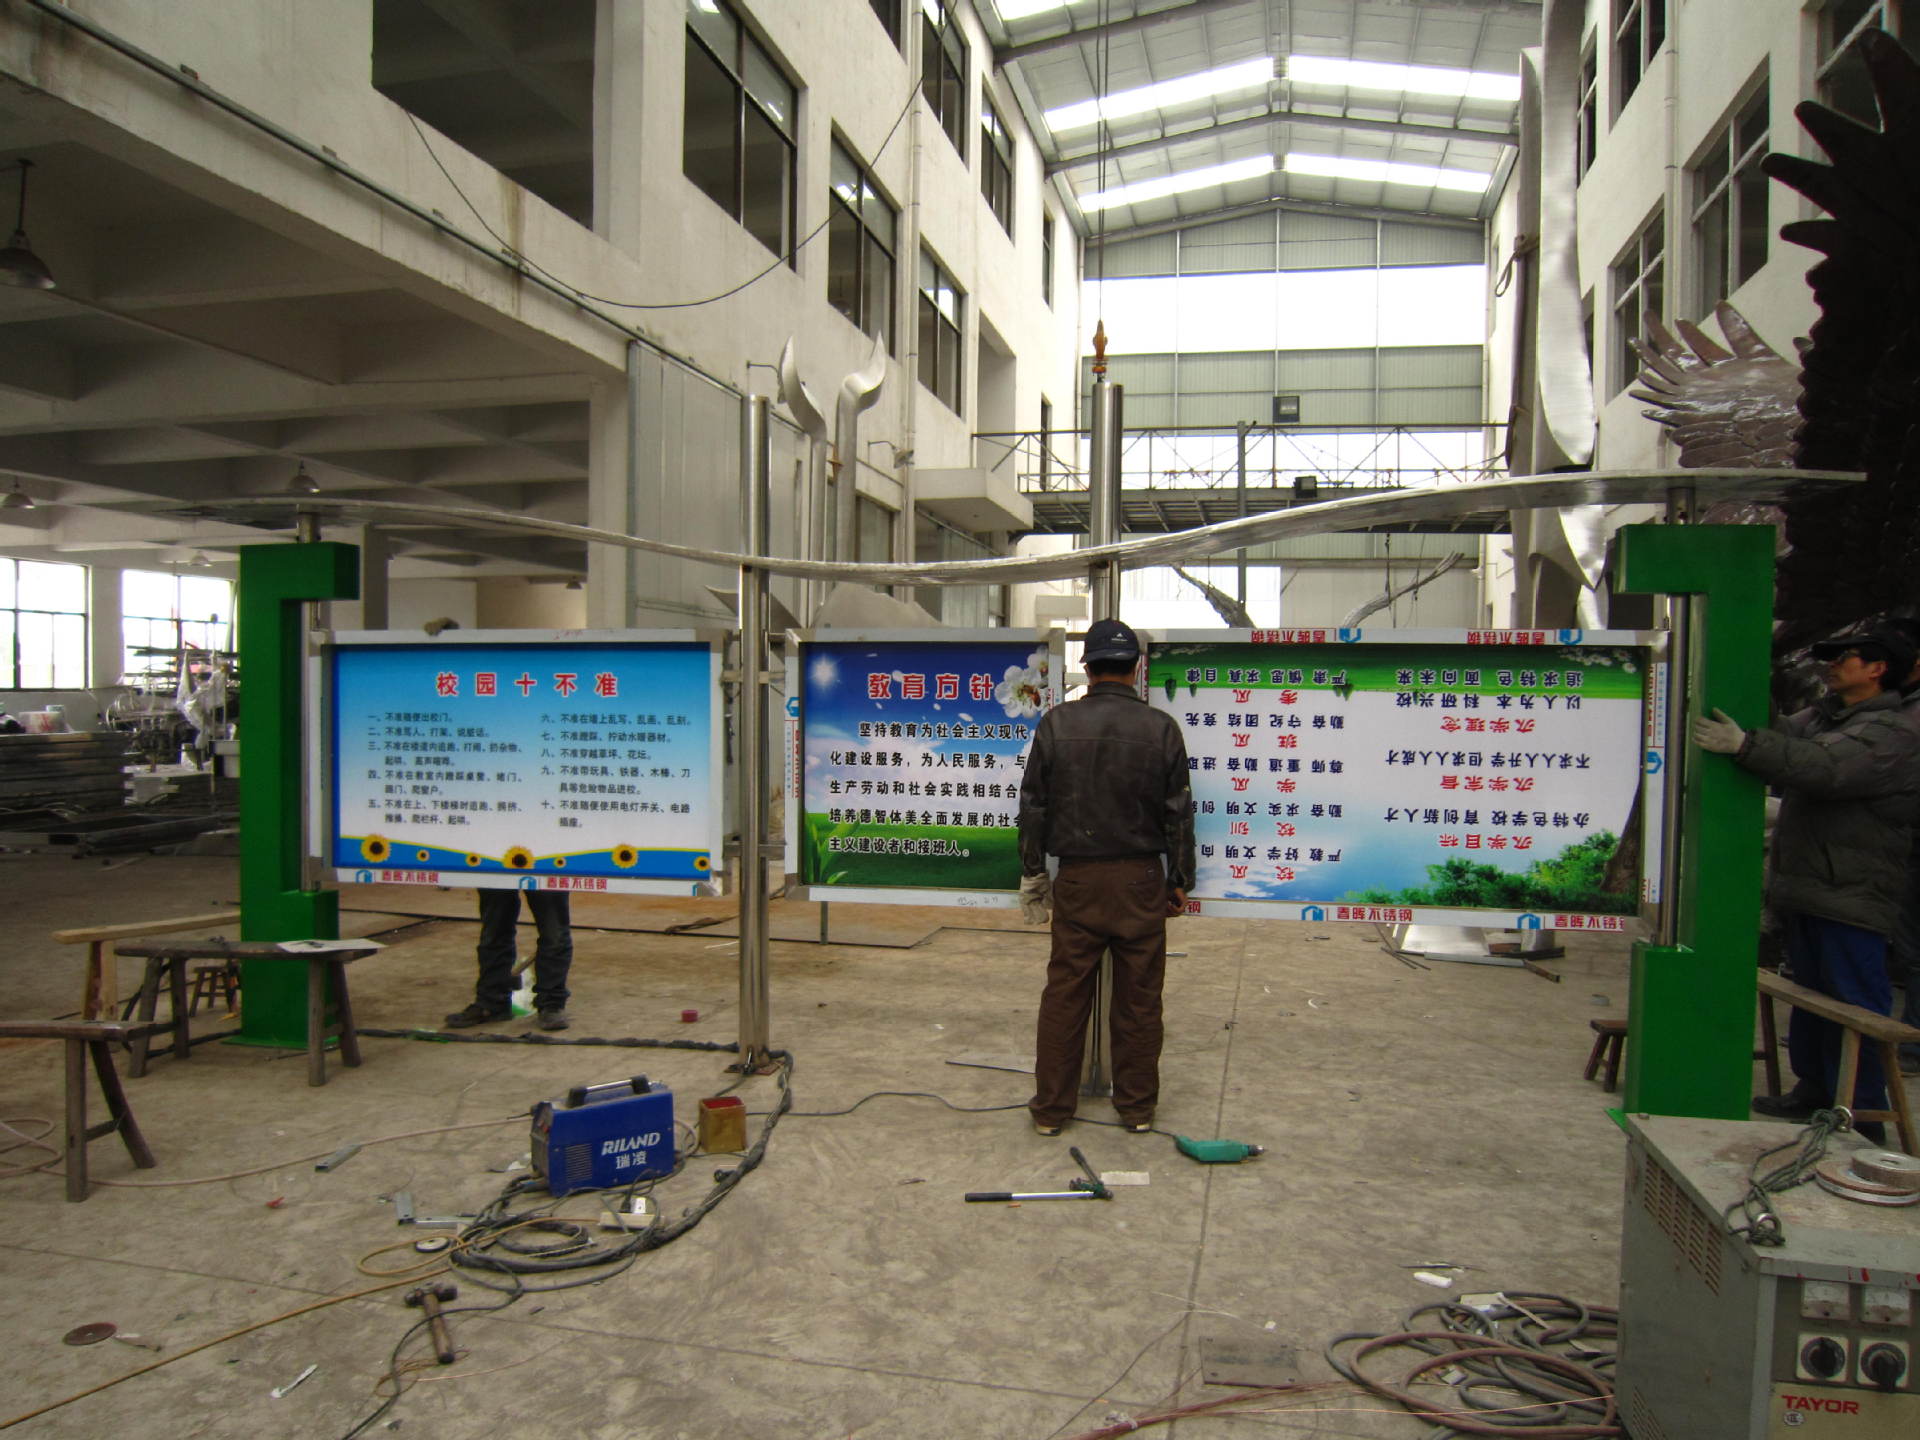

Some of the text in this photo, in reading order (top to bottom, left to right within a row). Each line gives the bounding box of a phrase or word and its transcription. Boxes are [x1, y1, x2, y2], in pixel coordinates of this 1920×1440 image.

[1185, 668, 1345, 685] 严肃 慎思 求真 自律
[1396, 669, 1582, 686] 追求特色 面向未来
[436, 672, 618, 698] 校园十不准
[867, 673, 995, 700] 教育方针
[1232, 689, 1298, 705] 考风
[1395, 692, 1581, 710] 以人为本 科研兴校
[1185, 713, 1344, 728] 勤奋 守纪 团结 竞先
[1440, 716, 1535, 733] 办学理念
[859, 722, 1028, 740] 坚持教育为社会主义现代
[1232, 733, 1297, 749] 班风
[1227, 758, 1258, 771] 勤奋
[1269, 759, 1300, 772] 重道
[1311, 760, 1343, 773] 尊师
[1385, 749, 1590, 768] 不求人人升学 但求人人成才
[830, 780, 1018, 799] 生产劳动和社会实践相结合
[1231, 777, 1296, 793] 学风
[1440, 775, 1534, 792] 办学宗旨
[1226, 801, 1257, 815] 文明
[1268, 802, 1299, 816] 求实
[1310, 804, 1342, 817] 勤奋
[1384, 808, 1590, 828] 办特色学校 育创新人才
[1230, 821, 1295, 837] 校训
[829, 838, 969, 857] 主义建设者和接班人。
[1438, 834, 1532, 850] 办学目标
[1225, 845, 1256, 859] 文明
[1267, 847, 1298, 861] 好学
[1309, 848, 1341, 862] 严教
[1229, 865, 1294, 881] 校风
[601, 1132, 661, 1156] RILAND
[616, 1151, 647, 1170] 瑞凌
[1782, 1395, 1860, 1415] TAYOR
